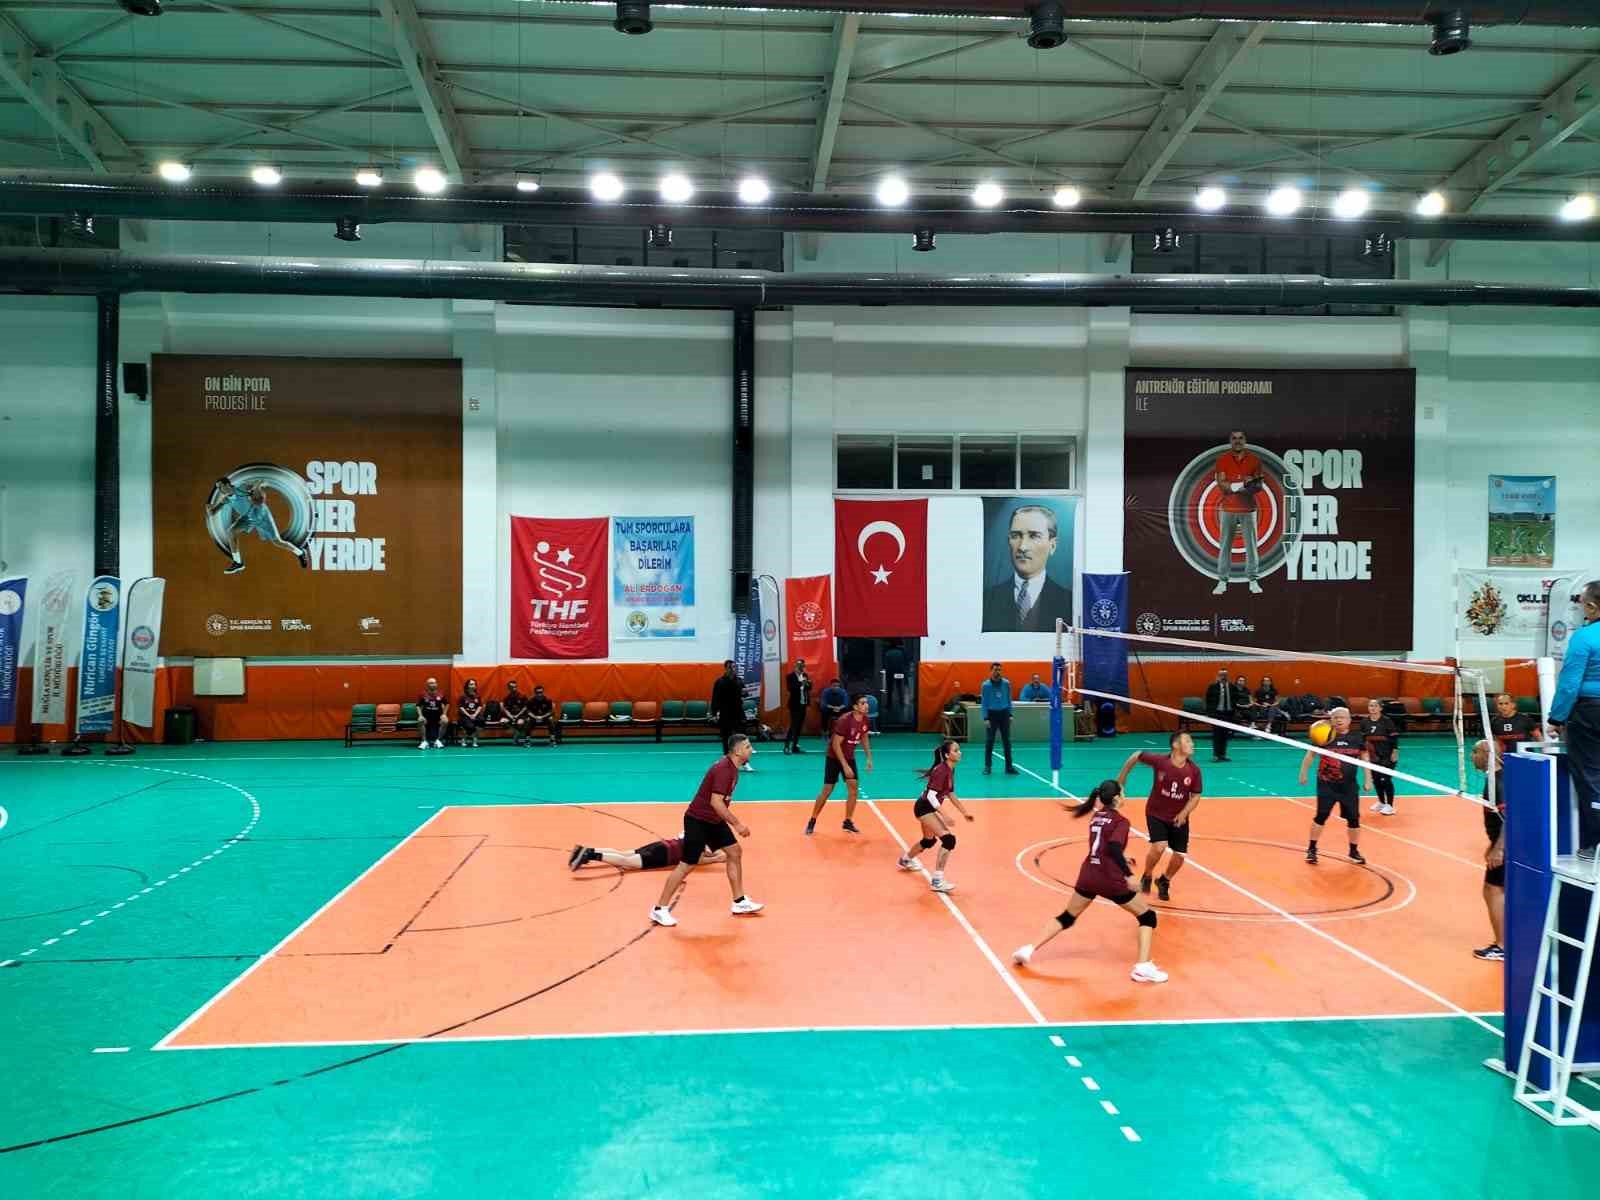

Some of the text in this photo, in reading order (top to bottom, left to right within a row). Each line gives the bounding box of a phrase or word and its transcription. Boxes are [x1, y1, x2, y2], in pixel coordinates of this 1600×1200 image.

[205, 374, 271, 392] ON BİN POTA
[1135, 377, 1272, 394] ANTRENÖR EĞİTİM PROGRAMI
[205, 393, 266, 411] PROJESİ İLE
[1135, 396, 1149, 411] İLE
[305, 460, 378, 496] SPOR
[1282, 449, 1363, 490] SPOR
[309, 499, 355, 533] HER
[634, 521, 691, 534] SPORCULARA
[1283, 495, 1339, 535] HER
[308, 537, 386, 571] YERDE
[630, 540, 678, 553] BAŞARILAR
[638, 556, 672, 570] DİLERİM
[1282, 541, 1373, 581] YERDE
[530, 599, 589, 621] THF
[86, 611, 101, 651] Güngör
[1091, 826, 1102, 857] 7
